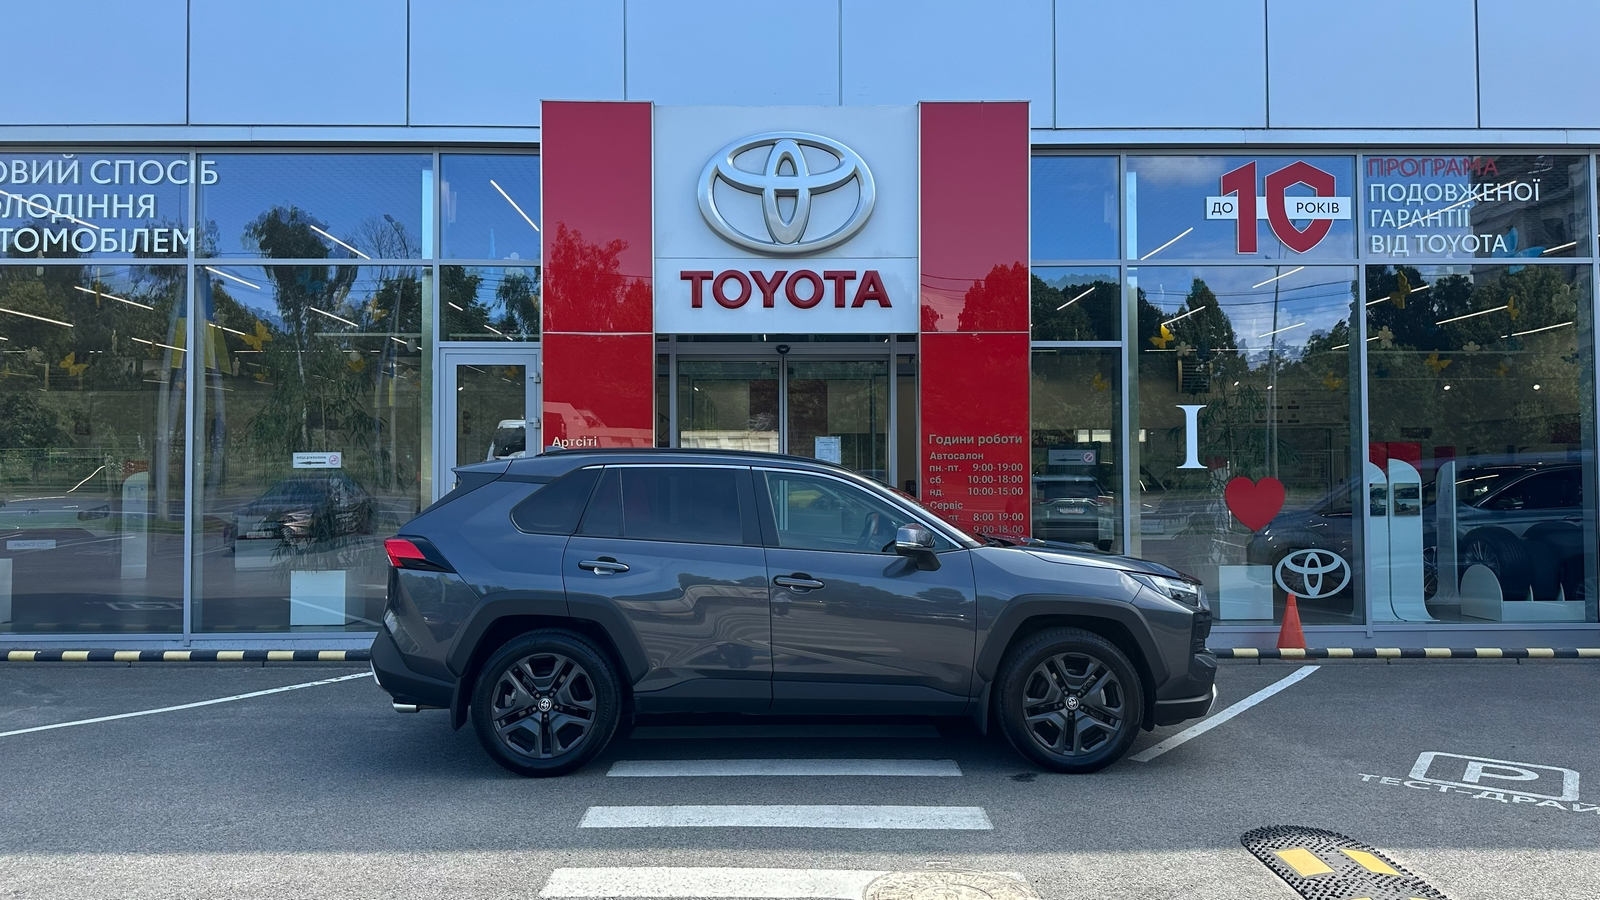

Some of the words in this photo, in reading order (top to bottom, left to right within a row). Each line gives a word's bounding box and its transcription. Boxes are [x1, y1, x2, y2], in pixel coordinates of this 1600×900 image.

[90, 159, 219, 185] СПОСІБ
[1368, 157, 1500, 177] ПРОГРАМА
[1370, 178, 1541, 206] ПОДОВЖЕНОЇ
[0, 193, 155, 224] ЛОДІННЯ
[1211, 202, 1234, 215] ДО
[1220, 159, 1337, 255] 10
[1296, 202, 1340, 213] РОКІВ
[1371, 204, 1471, 228] ГАРАНТІЇ
[0, 227, 195, 253] ТОМОБІЛЕМ
[1371, 234, 1410, 257] ВІД
[1415, 234, 1509, 254] TOYOTA
[680, 269, 893, 309] TOYOTA
[552, 436, 597, 449] Артсіті
[928, 434, 975, 446] Години
[978, 434, 1023, 447] роботи
[929, 451, 984, 461] Автосалон
[929, 464, 962, 472] пн.-пт.
[972, 463, 1024, 472] 9:00-19:00
[929, 475, 945, 484] сб.
[967, 474, 1024, 484] 10:00-18:00
[929, 487, 945, 497] нд.
[967, 486, 1024, 496] 10:00-15:00
[929, 501, 964, 512] Сервіс
